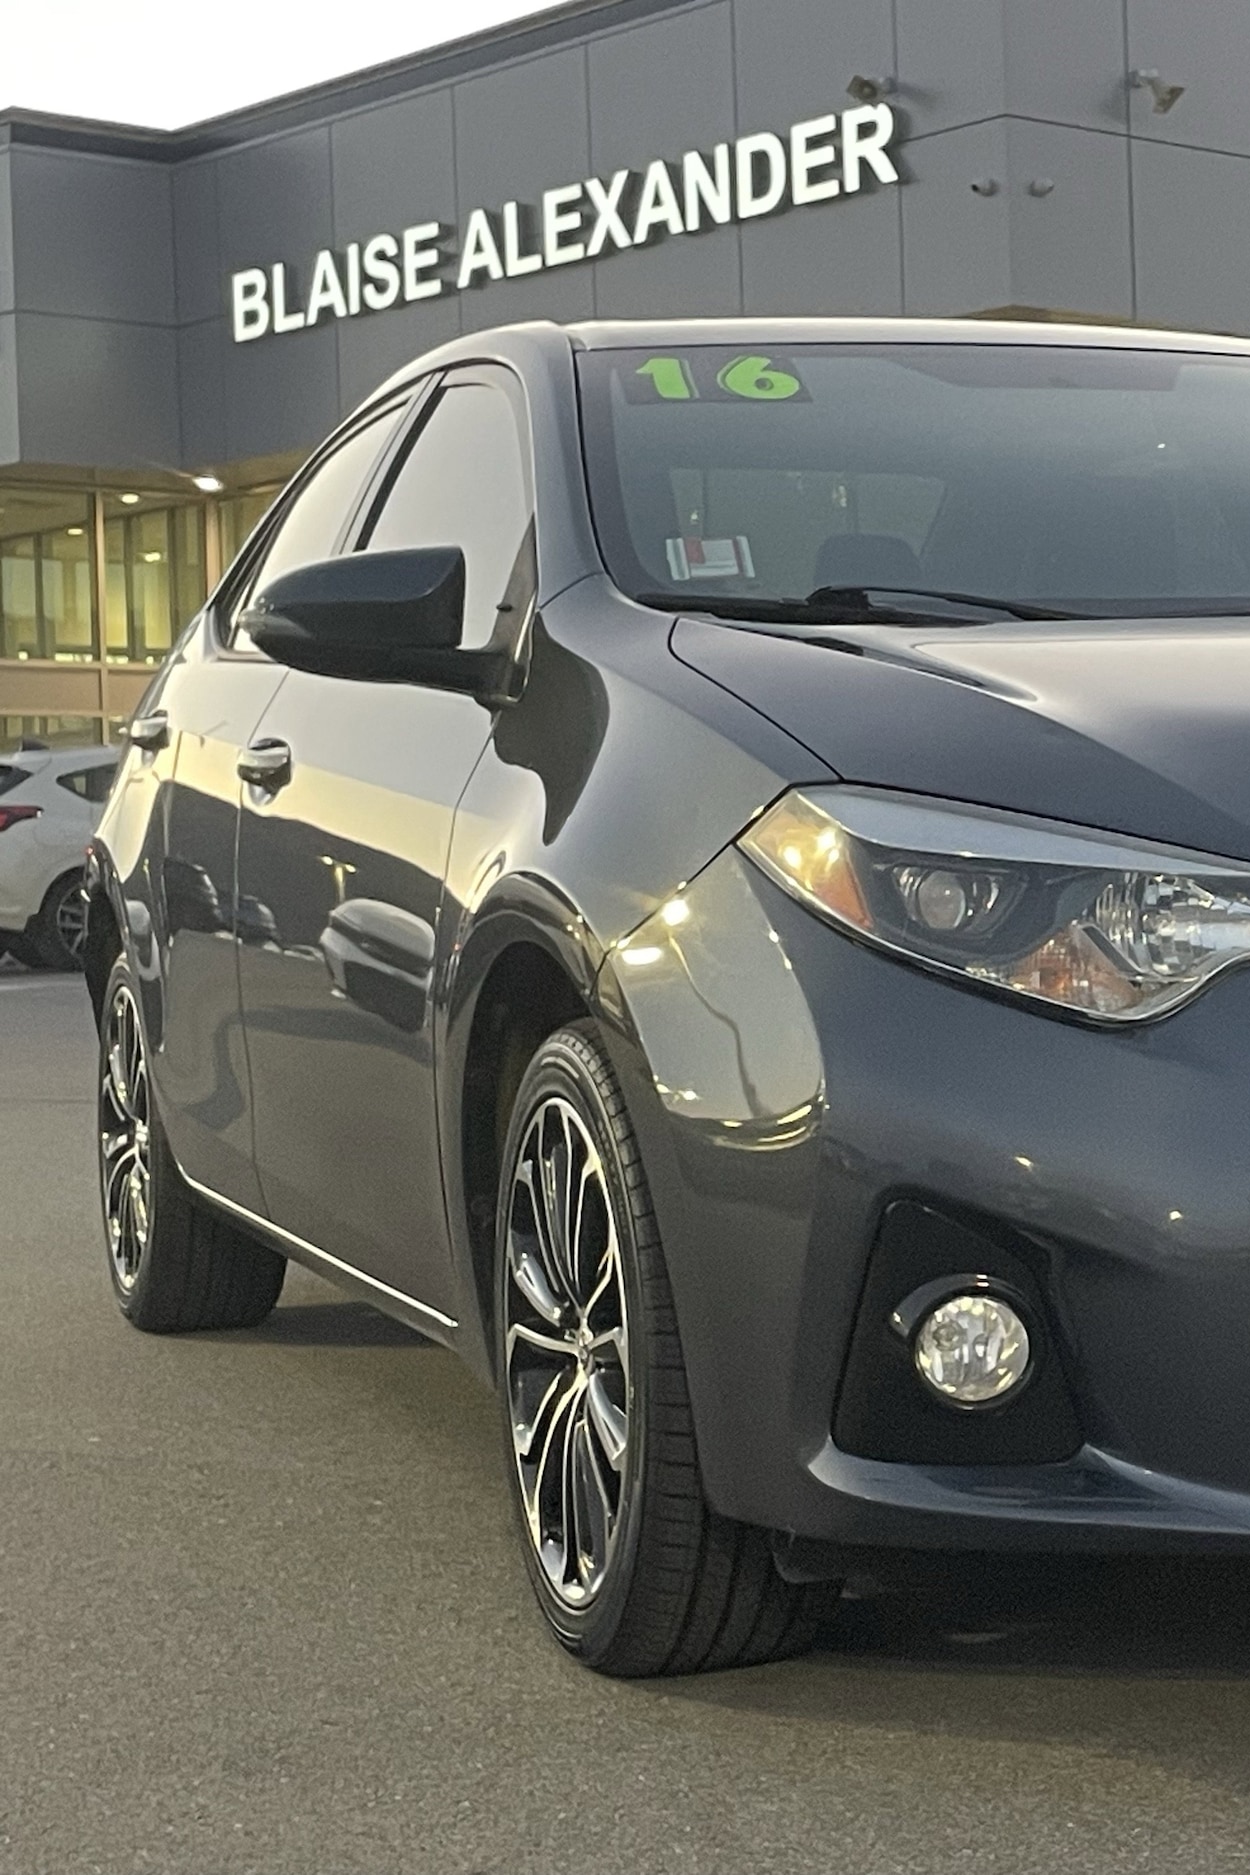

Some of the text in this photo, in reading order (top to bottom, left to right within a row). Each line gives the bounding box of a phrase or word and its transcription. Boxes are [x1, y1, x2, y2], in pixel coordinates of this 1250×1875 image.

[231, 101, 901, 343] BLAISE ALEXANDER
[635, 355, 800, 401] 16
